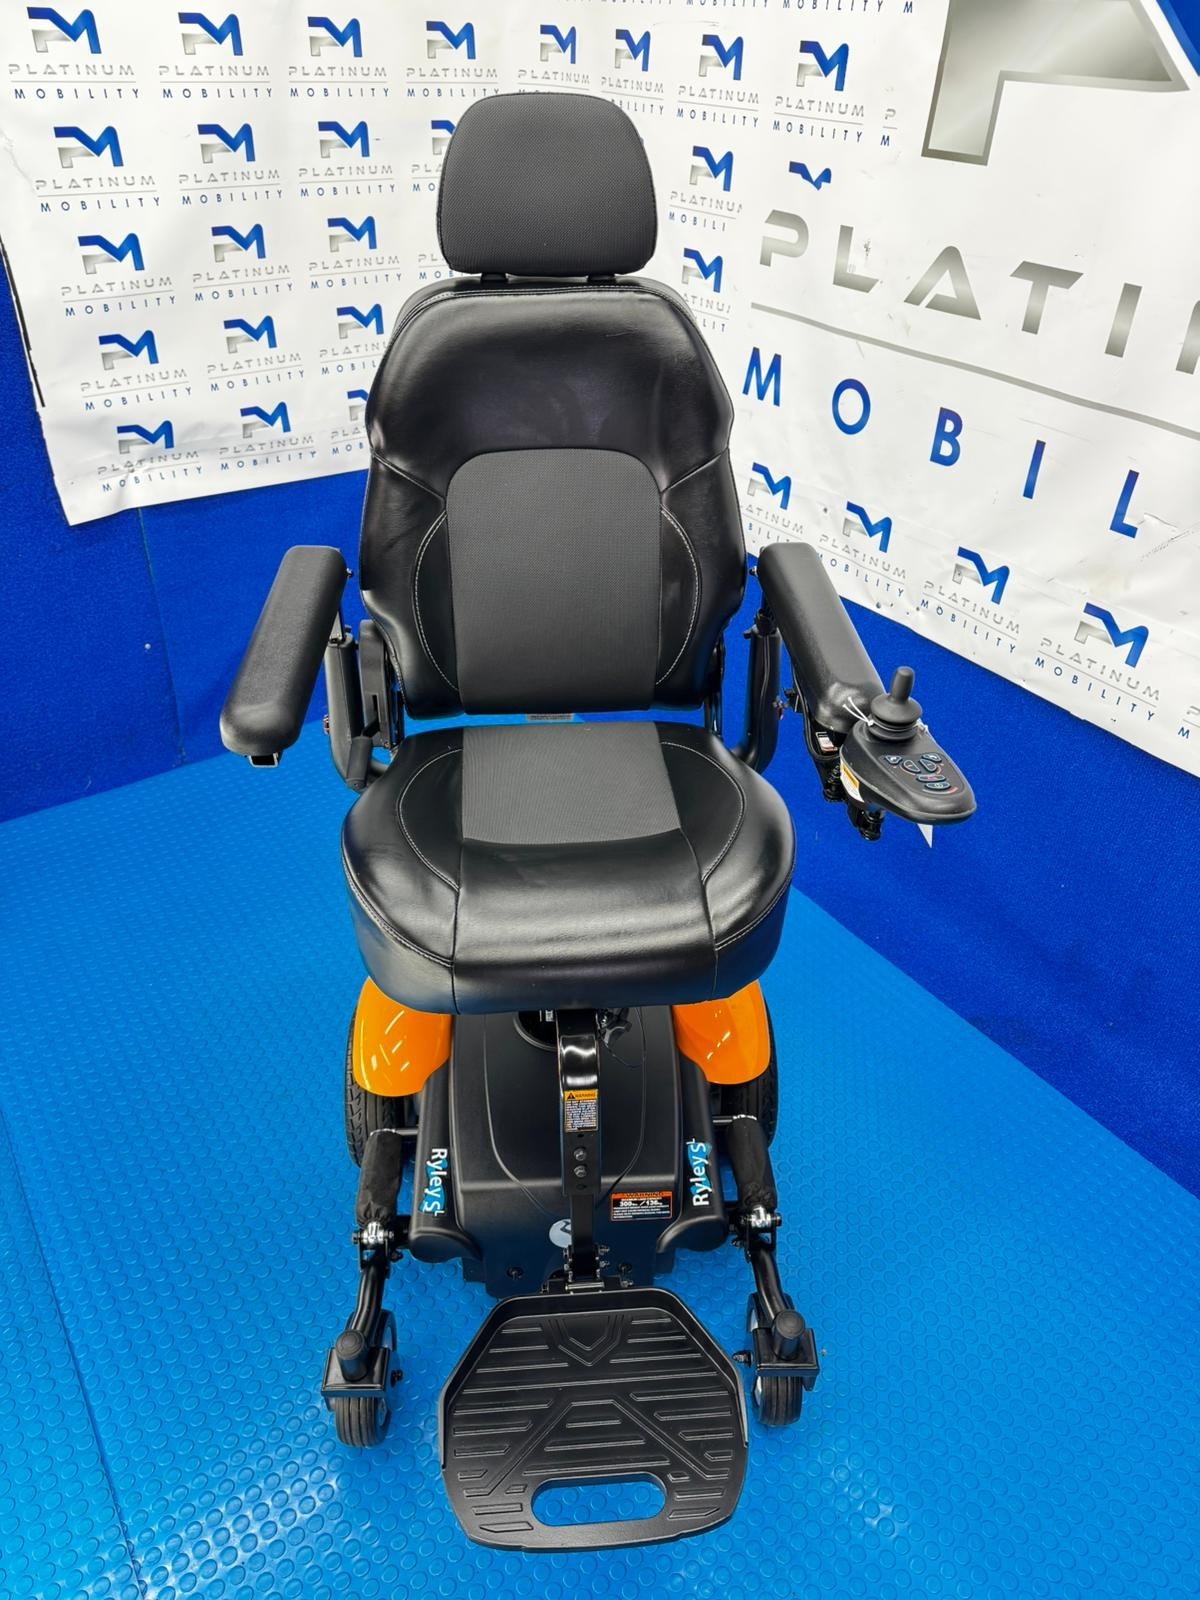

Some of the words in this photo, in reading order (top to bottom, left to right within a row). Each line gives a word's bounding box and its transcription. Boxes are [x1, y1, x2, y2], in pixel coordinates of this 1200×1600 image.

[8, 63, 135, 76] PLATINUM
[159, 65, 270, 77] PLATINUM
[288, 66, 388, 78] PLATINUM
[406, 67, 499, 79] PLATINUM
[518, 69, 590, 85] PLATINUM
[15, 88, 139, 99] MOBILITY
[163, 88, 273, 99] MOBILITY
[290, 87, 390, 98] MOBILITY
[601, 76, 664, 94] PLATINUM
[678, 85, 760, 105] PLATINUM
[775, 95, 865, 118] PLATINUM
[676, 108, 760, 128] MOBILITY
[772, 120, 863, 143] MOBILITY
[178, 168, 281, 185] PLATINUM
[298, 164, 394, 178] PLATINUM
[35, 174, 157, 191] PLATINUM
[300, 184, 395, 198] MOBILITY
[40, 197, 161, 213] MOBILITY
[182, 189, 283, 206] MOBILITY
[308, 254, 401, 272] PLATINUM
[192, 264, 291, 283] PLATINUM
[310, 273, 402, 290] MOBILITY
[60, 276, 173, 296] PLATINUM
[195, 282, 294, 302] MOBILITY
[65, 295, 176, 317] MOBILITY
[207, 351, 302, 374] PLATINUM
[321, 360, 378, 376] MOBIL
[80, 368, 188, 392] PLATINUM
[210, 369, 304, 392] MOBILITY
[85, 386, 192, 412] MOBILITY
[219, 435, 315, 456] PLATINUM
[220, 450, 317, 471] MOBILITY
[819, 533, 908, 580] PLATINUM
[923, 579, 1020, 635] PLATINUM
[920, 599, 1016, 655] MOBILITY
[1040, 637, 1160, 701] PLATINUM
[1035, 657, 1154, 721] MOBILITY
